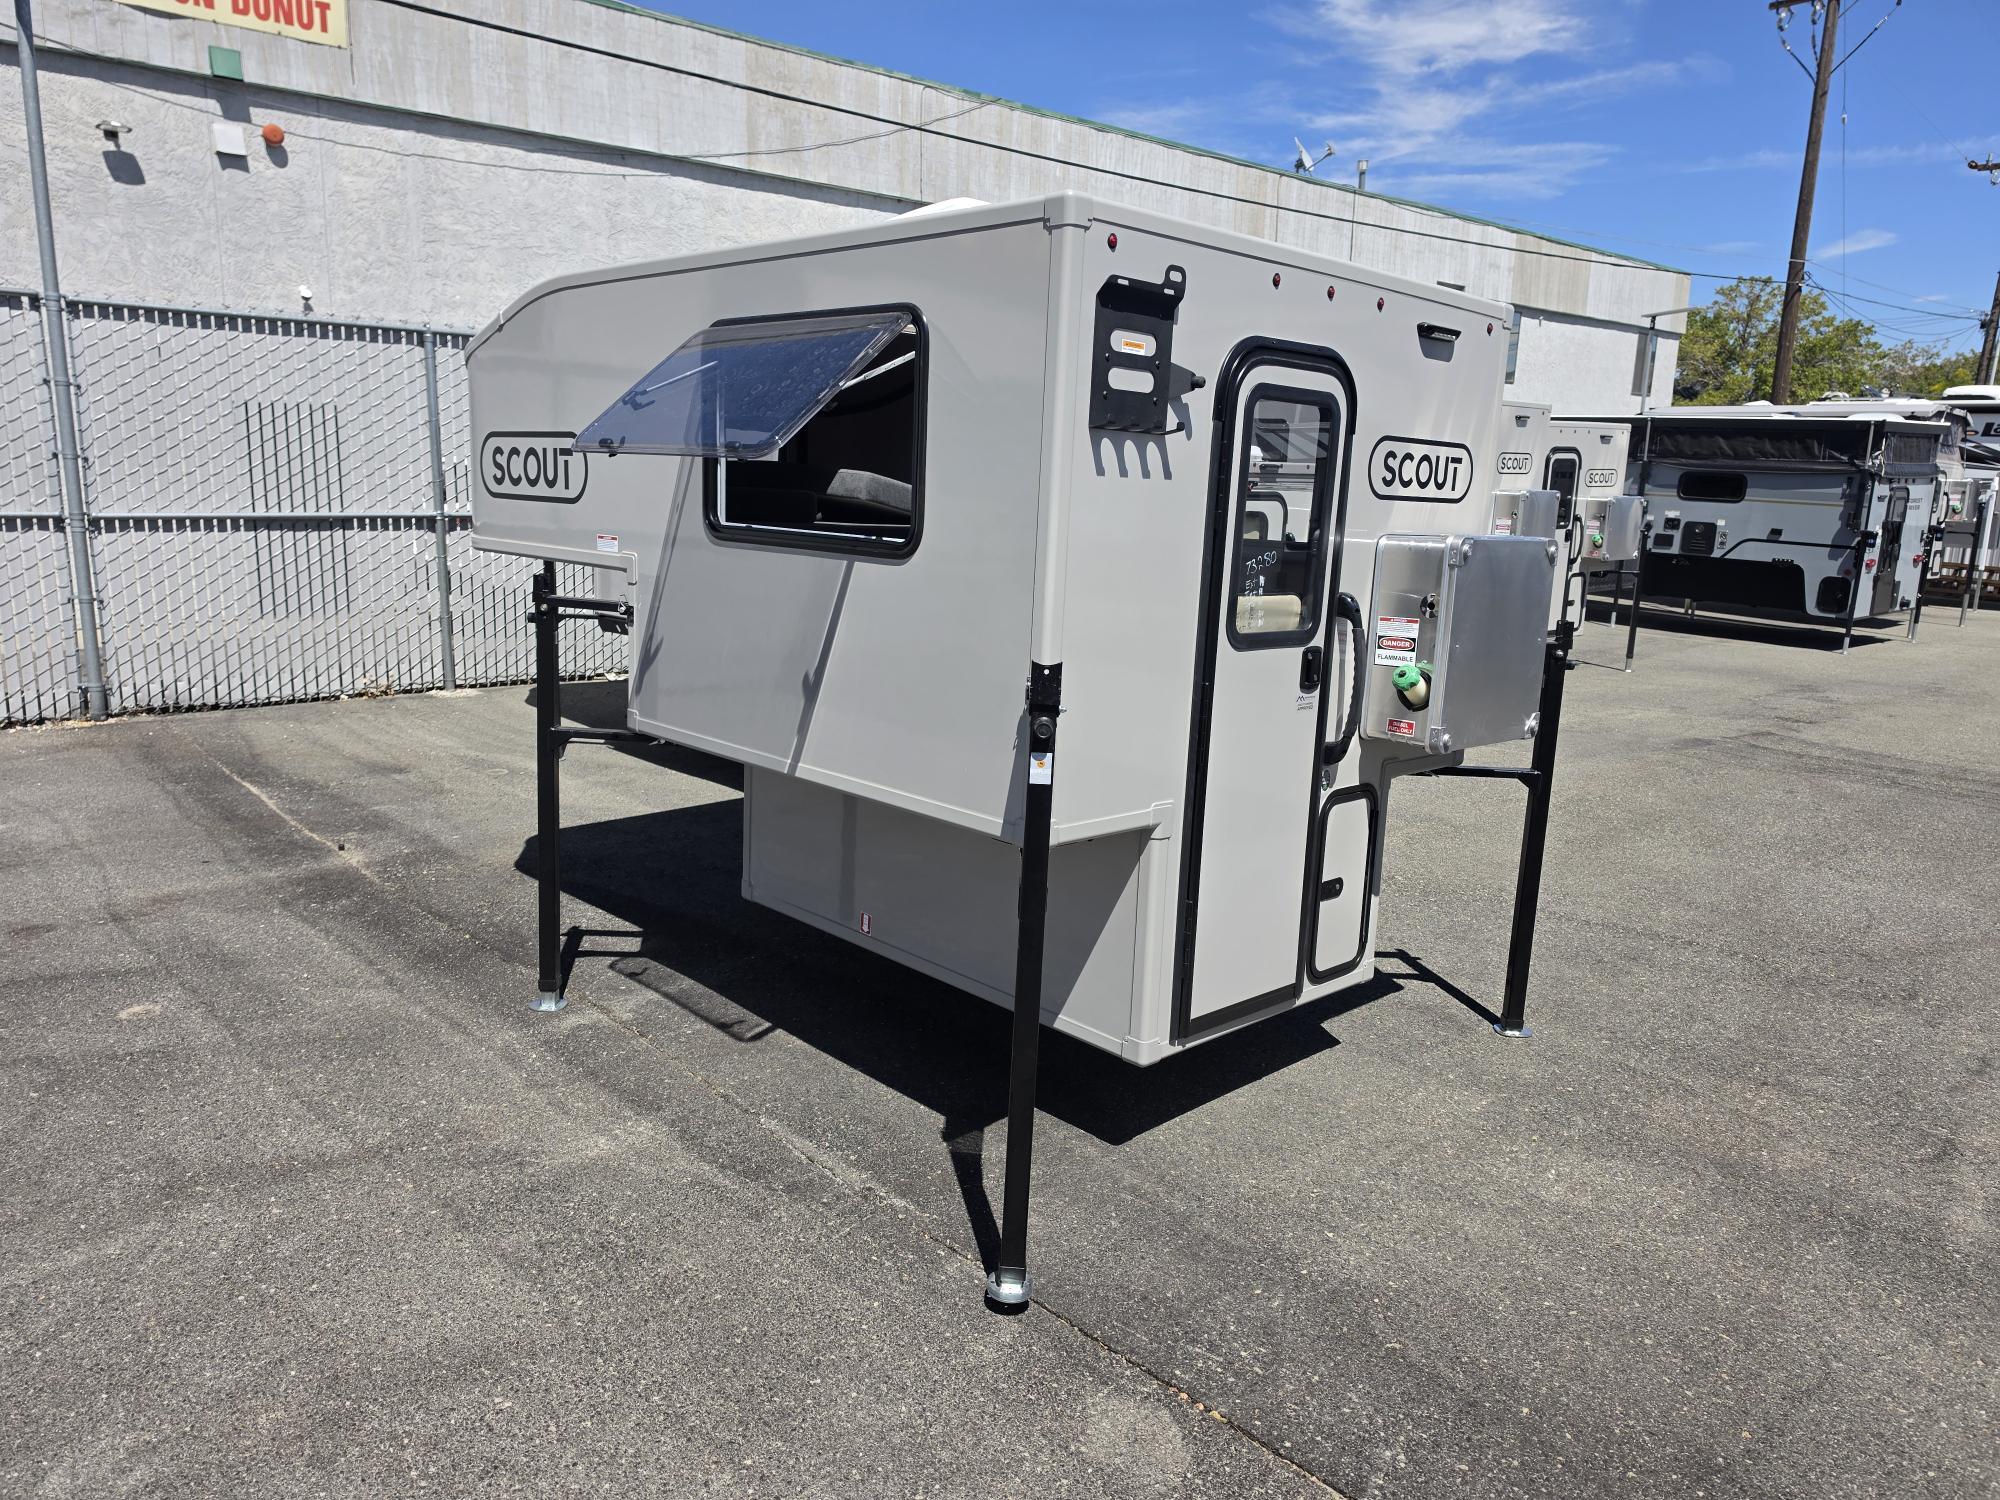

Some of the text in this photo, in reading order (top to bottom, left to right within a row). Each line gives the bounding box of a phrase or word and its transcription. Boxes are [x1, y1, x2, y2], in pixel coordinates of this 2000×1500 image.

[492, 446, 574, 490] SCOUT
[1500, 457, 1529, 470] SCOUT
[1381, 450, 1463, 491] SCOUT
[1588, 472, 1615, 484] SCOUT
[1382, 639, 1411, 648] DANGER
[1377, 653, 1414, 663] FLAMMABLE
